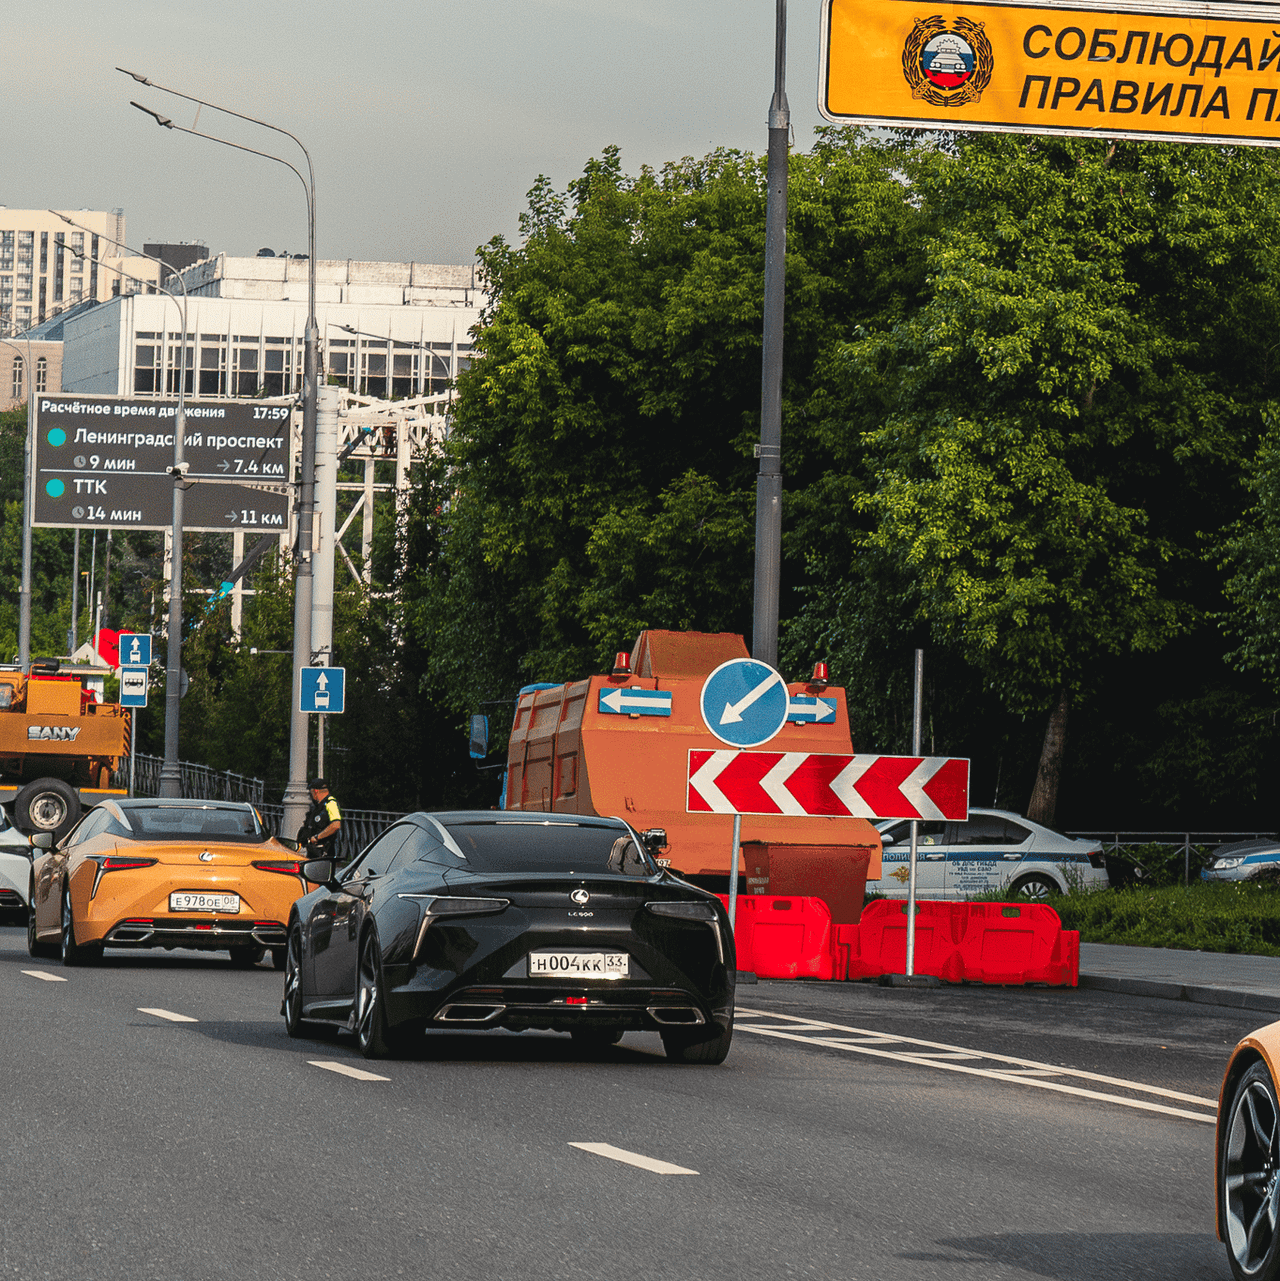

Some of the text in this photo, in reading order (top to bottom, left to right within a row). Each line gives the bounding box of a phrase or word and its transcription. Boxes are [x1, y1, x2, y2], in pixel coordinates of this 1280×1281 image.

[1018, 74, 1231, 120] ПРАВИЛА
[41, 400, 111, 415] Расчётное
[114, 405, 156, 418] время
[253, 407, 289, 420] 17:59
[73, 427, 284, 451] Ленинградсий проспект
[89, 454, 136, 471] 9 мин
[233, 459, 284, 474] 7.4 км
[73, 478, 108, 495] ТТК
[86, 505, 142, 521] 14 мин
[240, 509, 283, 525] 11 км
[27, 725, 81, 742] SANY
[882, 852, 926, 861] ПОЛИЯ
